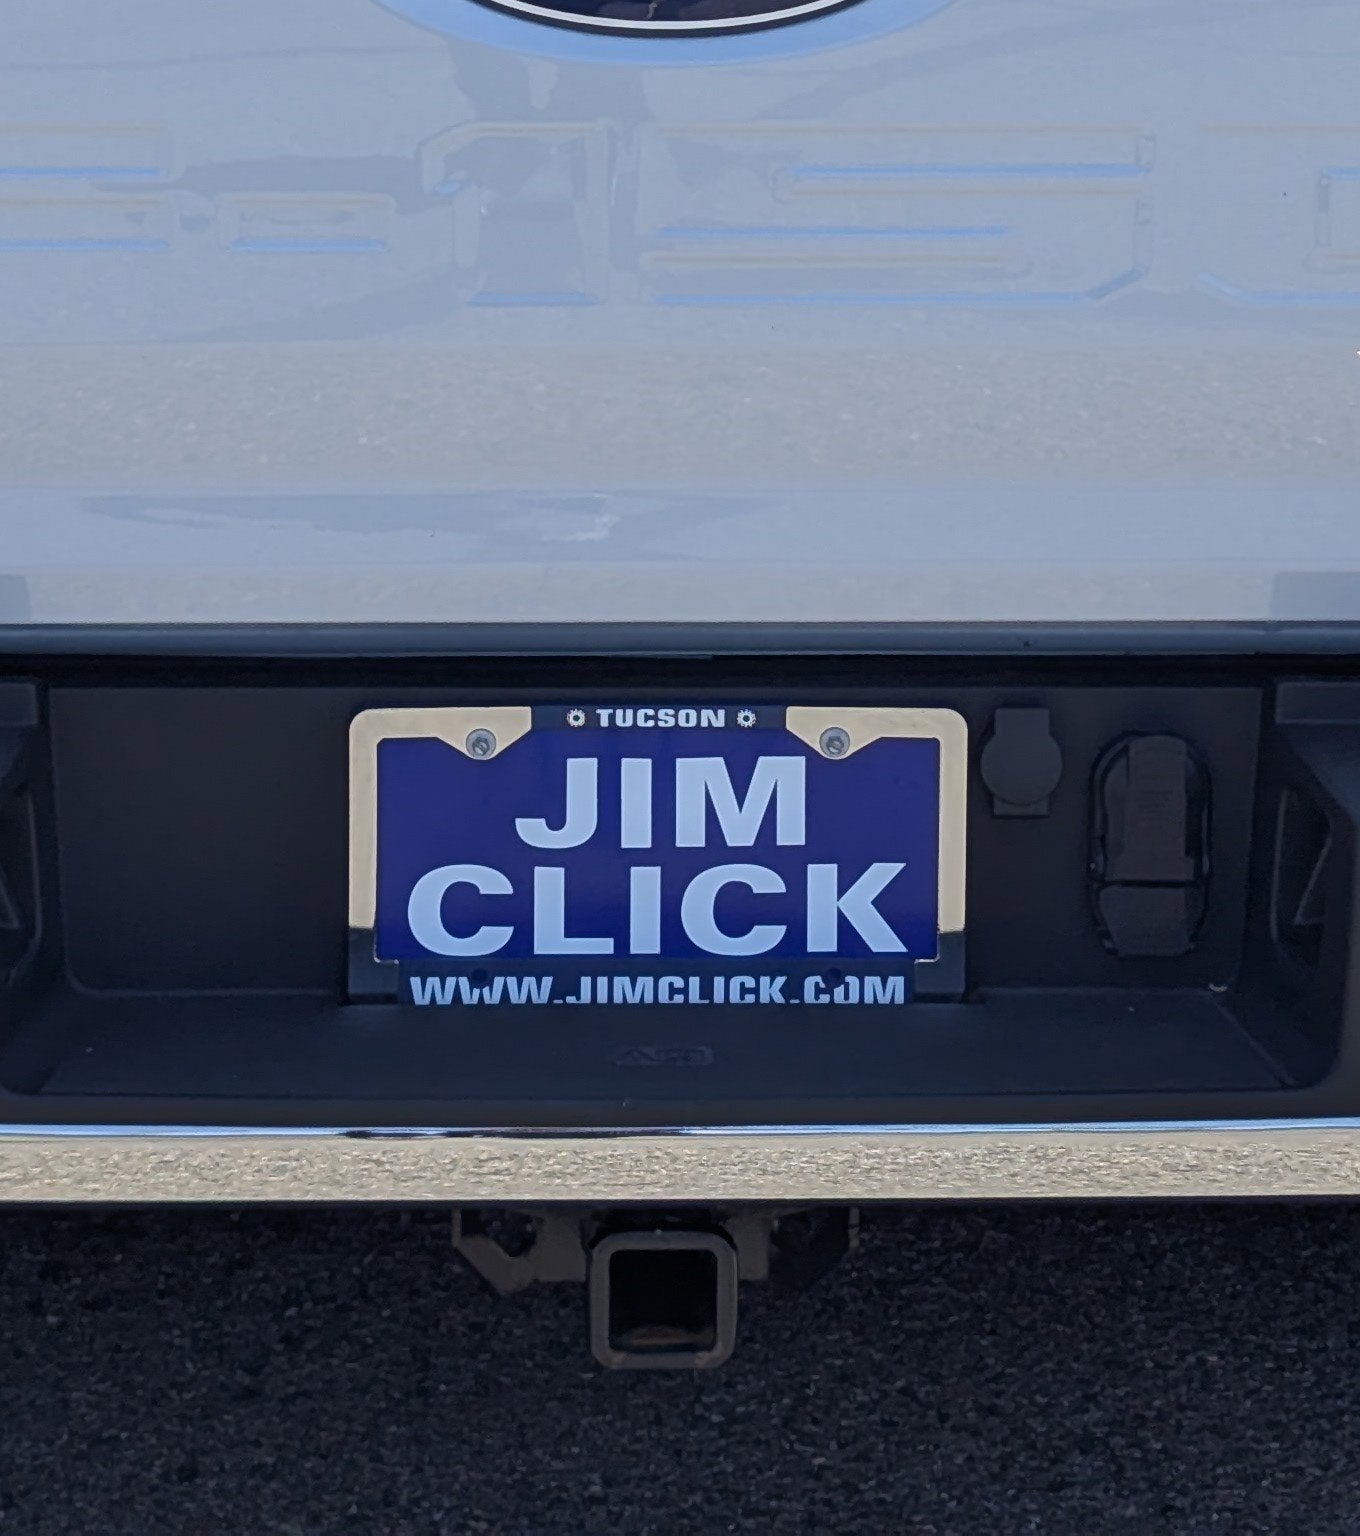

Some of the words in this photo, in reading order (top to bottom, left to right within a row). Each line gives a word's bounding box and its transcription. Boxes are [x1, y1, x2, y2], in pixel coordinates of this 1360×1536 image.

[596, 708, 726, 728] TUCSON
[515, 756, 806, 849] JIM
[407, 862, 909, 957] CLICK
[409, 975, 906, 1005] WWW.JIMCLICK.COM
